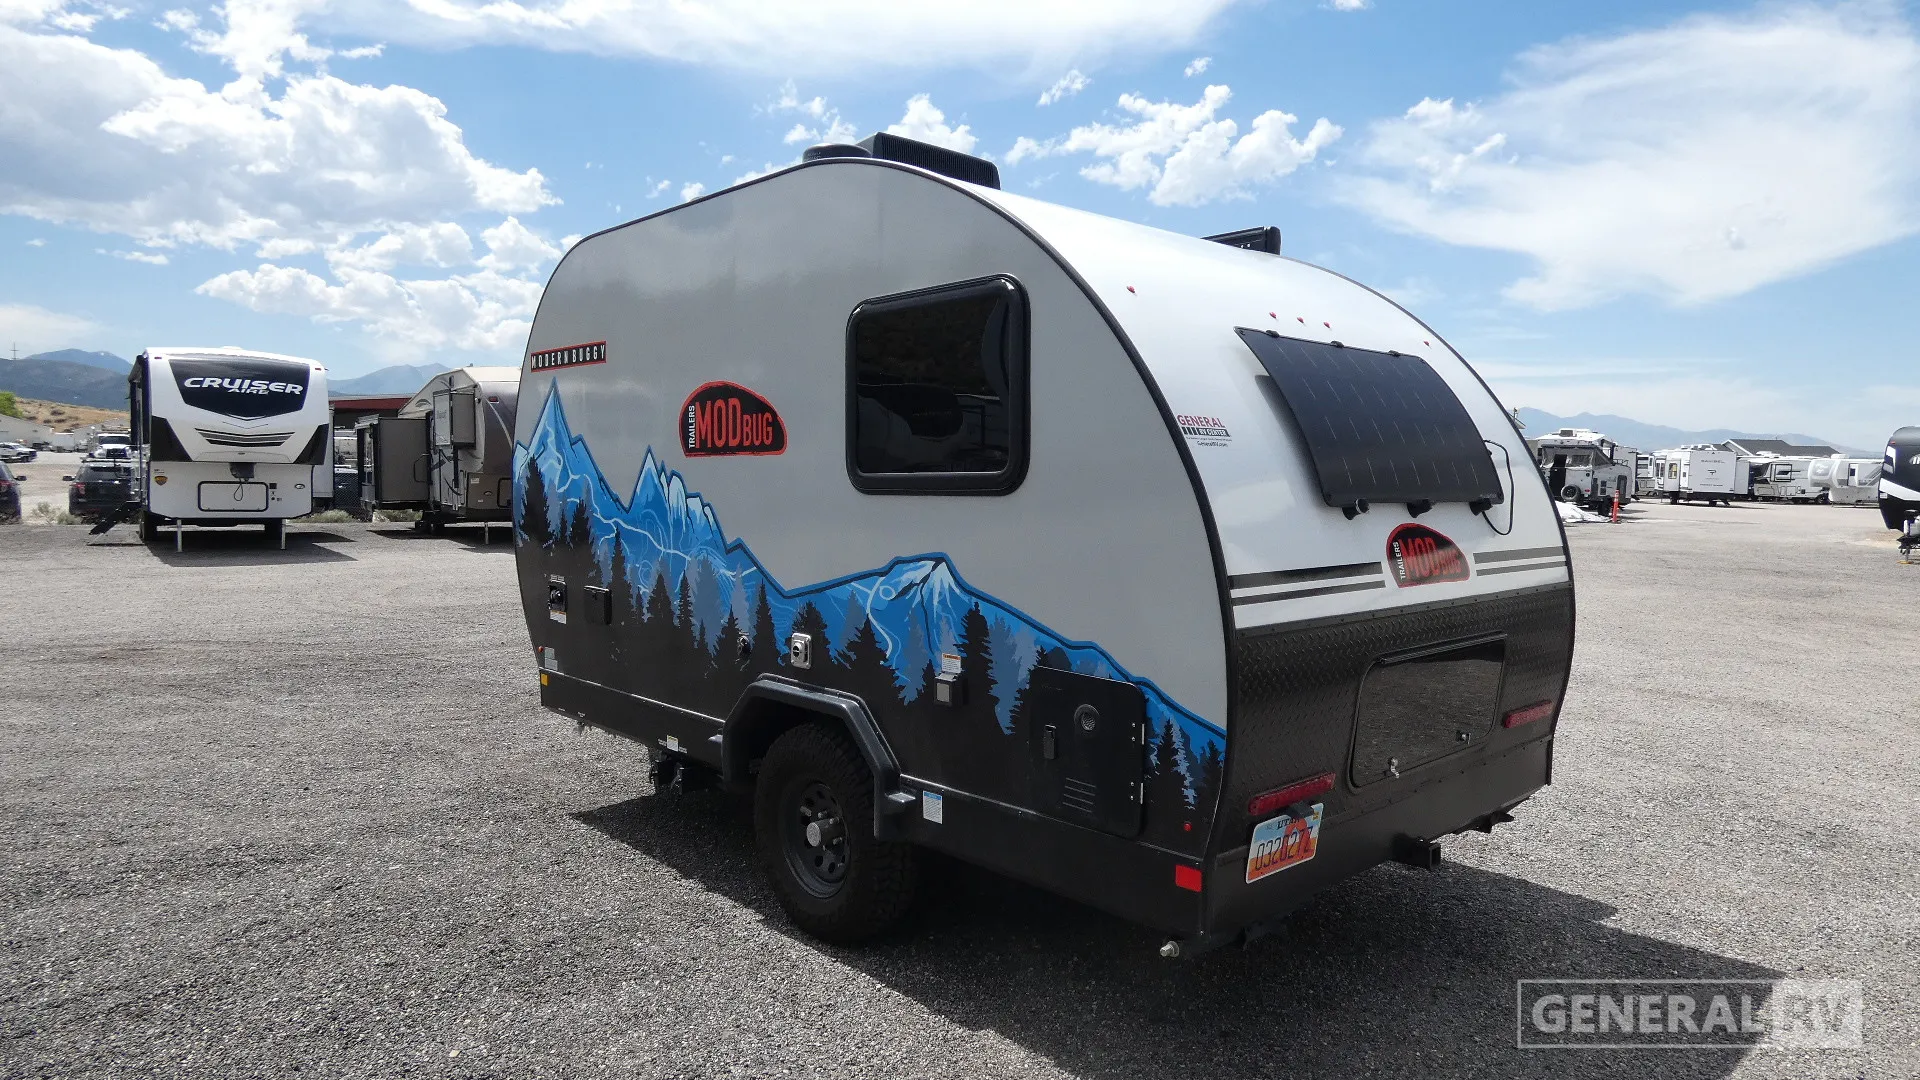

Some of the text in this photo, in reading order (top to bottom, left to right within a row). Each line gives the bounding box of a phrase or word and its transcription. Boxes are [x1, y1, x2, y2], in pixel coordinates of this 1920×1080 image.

[531, 344, 605, 369] MODERN BUGGY
[183, 377, 304, 395] CRUISER
[688, 405, 696, 449] TRAILERS
[1177, 414, 1226, 428] GENERAL
[1392, 541, 1407, 580] TRAILERS
